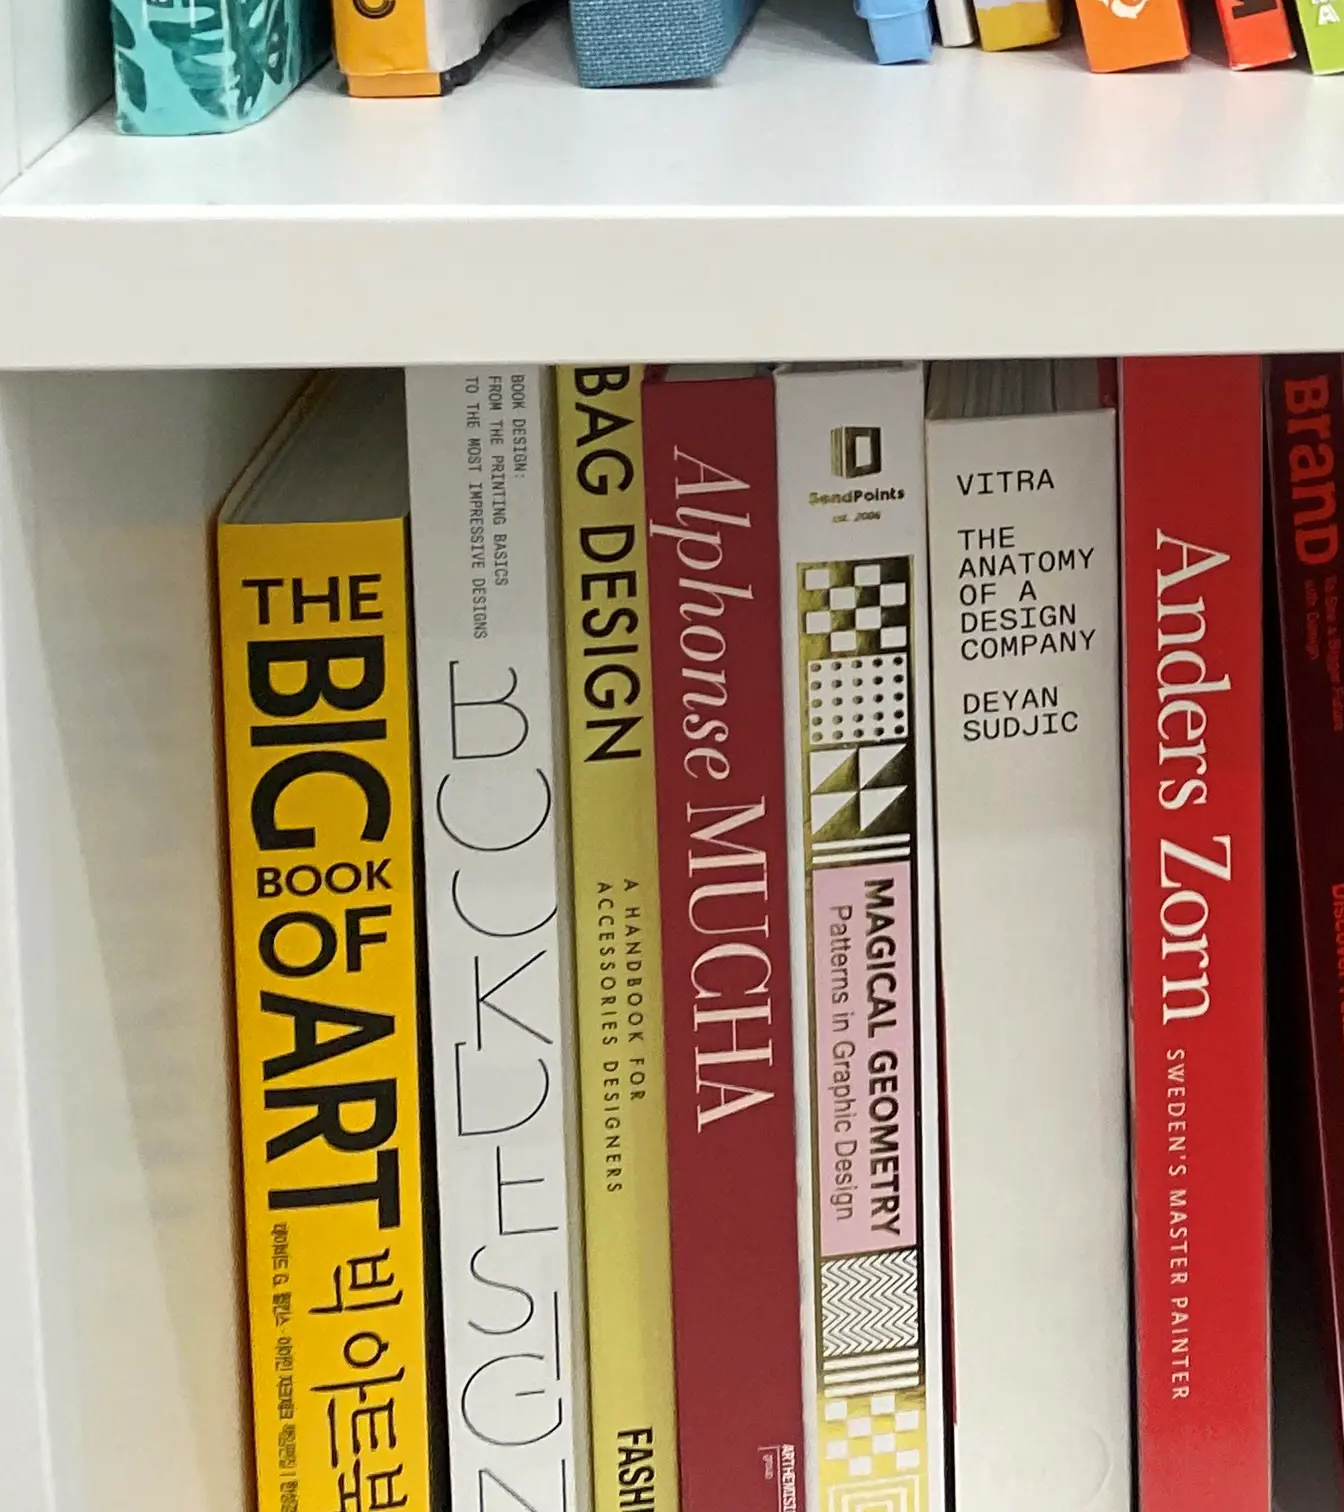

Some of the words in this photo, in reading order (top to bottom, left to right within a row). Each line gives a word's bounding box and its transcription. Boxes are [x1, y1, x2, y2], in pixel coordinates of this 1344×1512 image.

[466, 376, 478, 395] TO
[467, 403, 480, 428] THE
[488, 375, 500, 413] FROM
[512, 374, 524, 410] BOOK
[468, 437, 481, 474] MOST
[489, 420, 500, 445] THE
[512, 417, 526, 480] DESIGN:
[573, 366, 636, 497] BAG
[491, 455, 506, 526] PRINTING
[957, 469, 1055, 497] VITRA
[470, 482, 486, 570] IMPRESSIVE
[494, 534, 508, 587] BASICS
[958, 527, 1015, 551] THE
[958, 547, 1095, 579] ANATOMY
[959, 582, 997, 607] OF
[1019, 580, 1037, 603] A
[242, 574, 383, 626] THE
[472, 577, 487, 640] DESIGNS
[649, 445, 755, 780] Alphonse
[961, 603, 1076, 634] DESIGN
[579, 525, 643, 763] DESIGN
[961, 629, 1096, 662] COMPANY
[1155, 528, 1233, 812] Anders
[963, 686, 1059, 716] DEYAN
[963, 710, 1079, 742] SUDJIC
[247, 635, 391, 853] BIG
[256, 860, 392, 898] BOOK
[258, 904, 393, 978] OF
[597, 882, 618, 1046] ACCESSORIES
[686, 796, 775, 1133] MUCHA
[829, 905, 853, 1006] Patterns
[864, 878, 898, 1038] MAGICAL
[1159, 834, 1233, 1028] Zorn
[624, 906, 645, 1043] HANDBOOK
[832, 1011, 851, 1032] in
[260, 991, 401, 1231] ART
[630, 1059, 645, 1102] FOR
[831, 1041, 857, 1135] Graphic
[1165, 1048, 1188, 1178] SWEDEN'S
[604, 1062, 622, 1194] DESIGNERS
[868, 1051, 901, 1237] GEOMETRY
[834, 1139, 857, 1222] Design
[1169, 1189, 1189, 1286] MASTER
[1171, 1296, 1191, 1401] PAINTER
